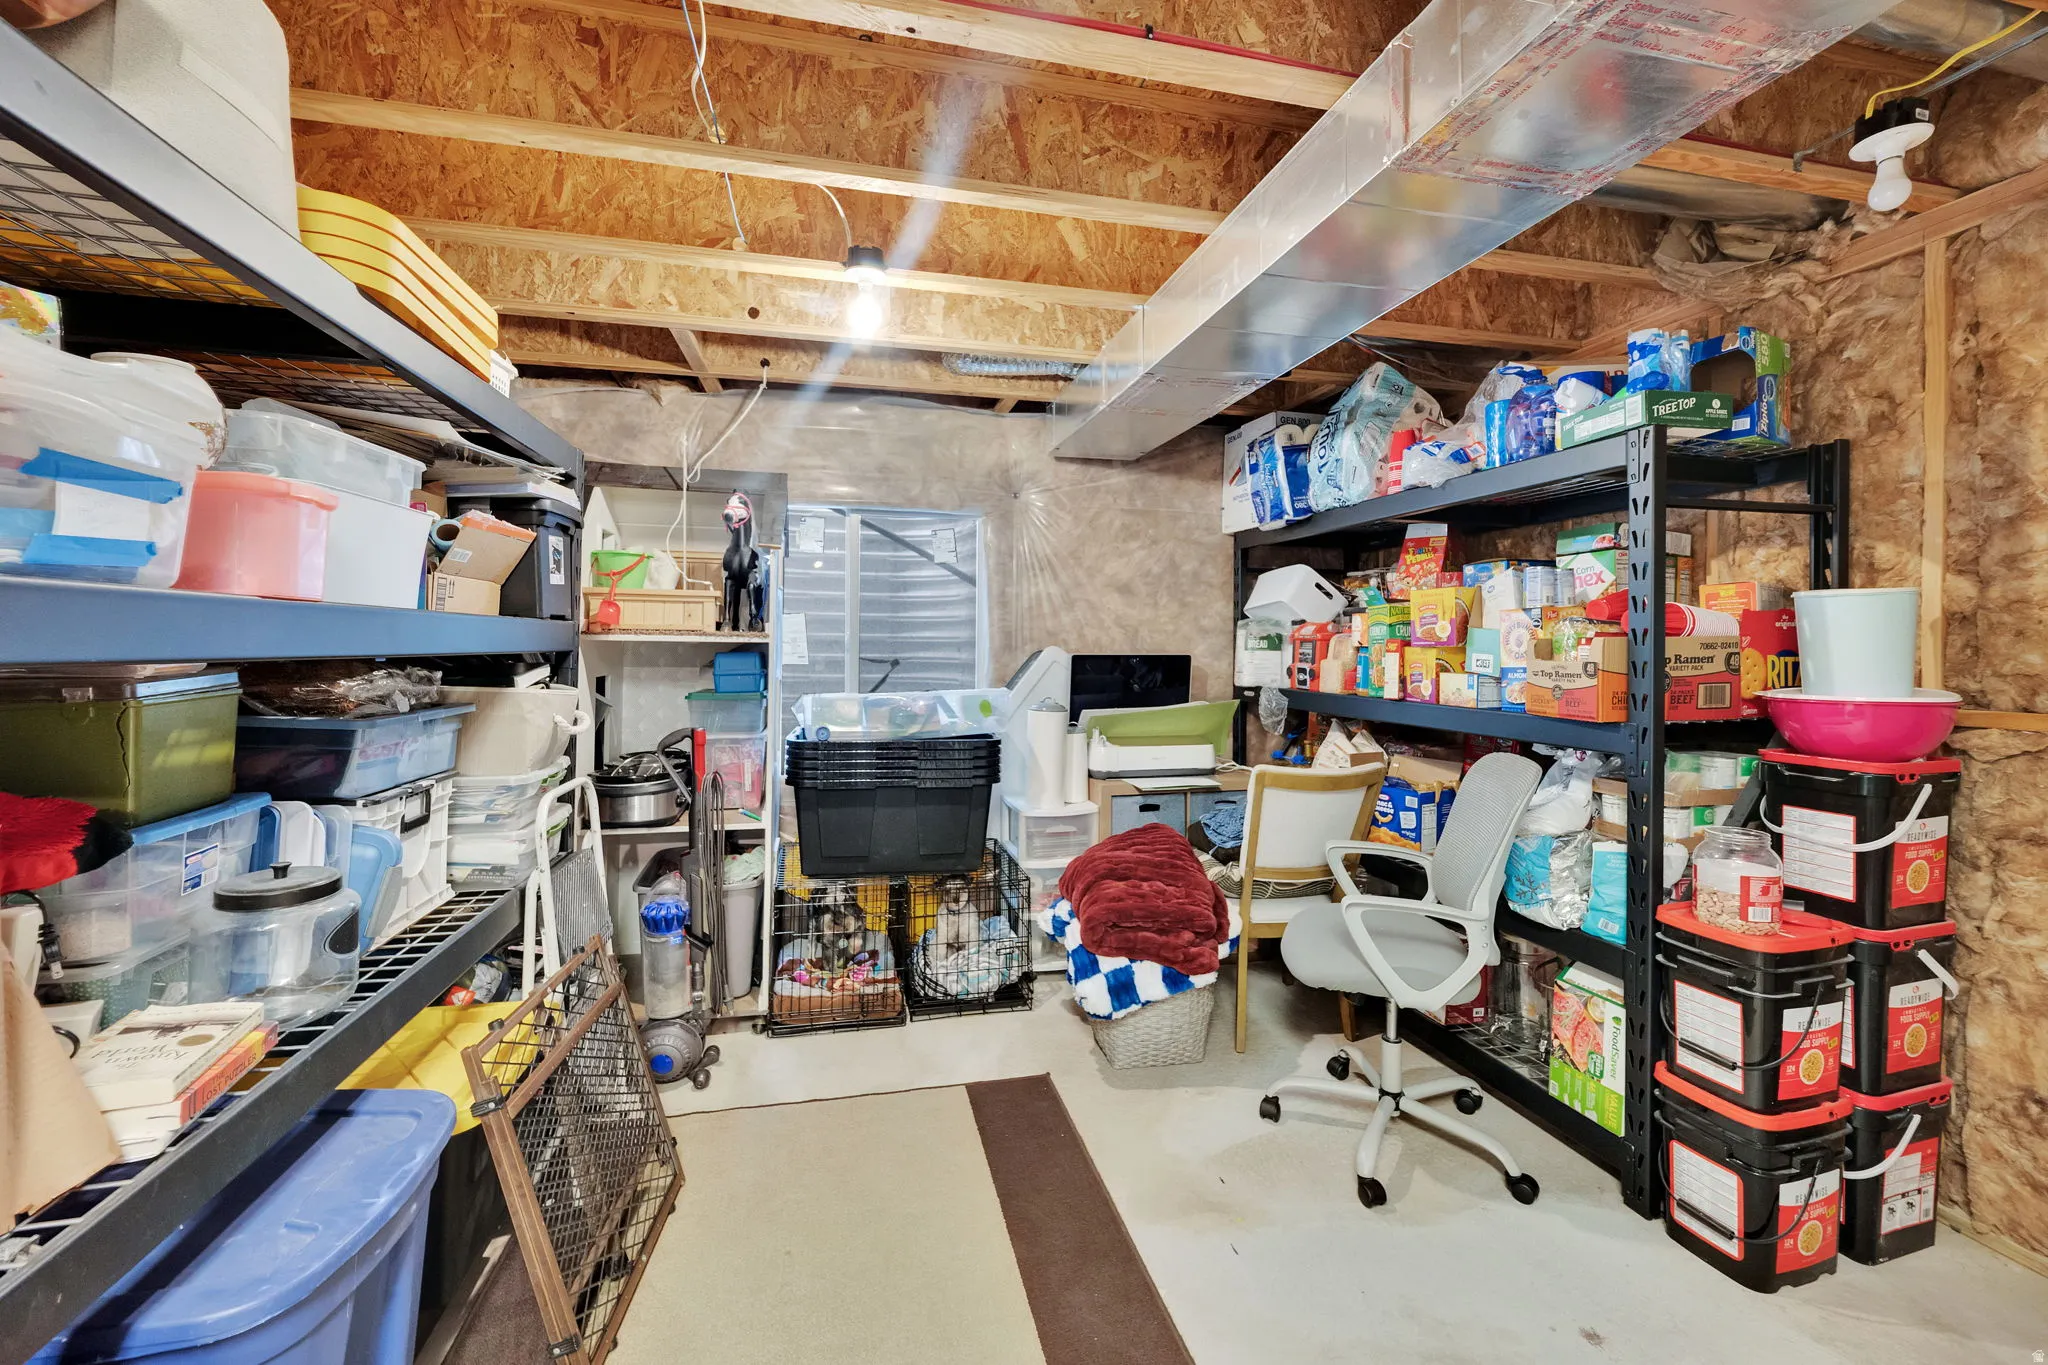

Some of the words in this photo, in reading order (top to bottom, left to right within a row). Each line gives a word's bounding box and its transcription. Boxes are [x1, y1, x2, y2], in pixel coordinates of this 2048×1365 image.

[1760, 333, 1769, 366] 580
[1760, 394, 1769, 433] Ziploc
[1280, 416, 1297, 424] GEN
[1576, 565, 1595, 575] Corn
[1574, 570, 1606, 589] hex
[1775, 619, 1797, 630] origina
[1247, 640, 1268, 648] BREAD
[1674, 654, 1714, 665] Ramen
[1540, 671, 1554, 679] Top
[1554, 671, 1582, 679] Ramen
[1670, 695, 1695, 704] BEEF
[1905, 851, 1917, 859] FOOD
[1917, 848, 1935, 857] SUPPLY
[1900, 1015, 1913, 1023] FOOD
[1913, 1010, 1930, 1021] SUPPLY
[1811, 1036, 1830, 1047] SUPPLY
[91, 1045, 168, 1059] World
[105, 1050, 190, 1065] Known
[1609, 1026, 1622, 1081] FoodSaver
[202, 1083, 224, 1106] LOST
[223, 1052, 258, 1087] PUZZLER
[1809, 1206, 1828, 1218] SUPPLY
